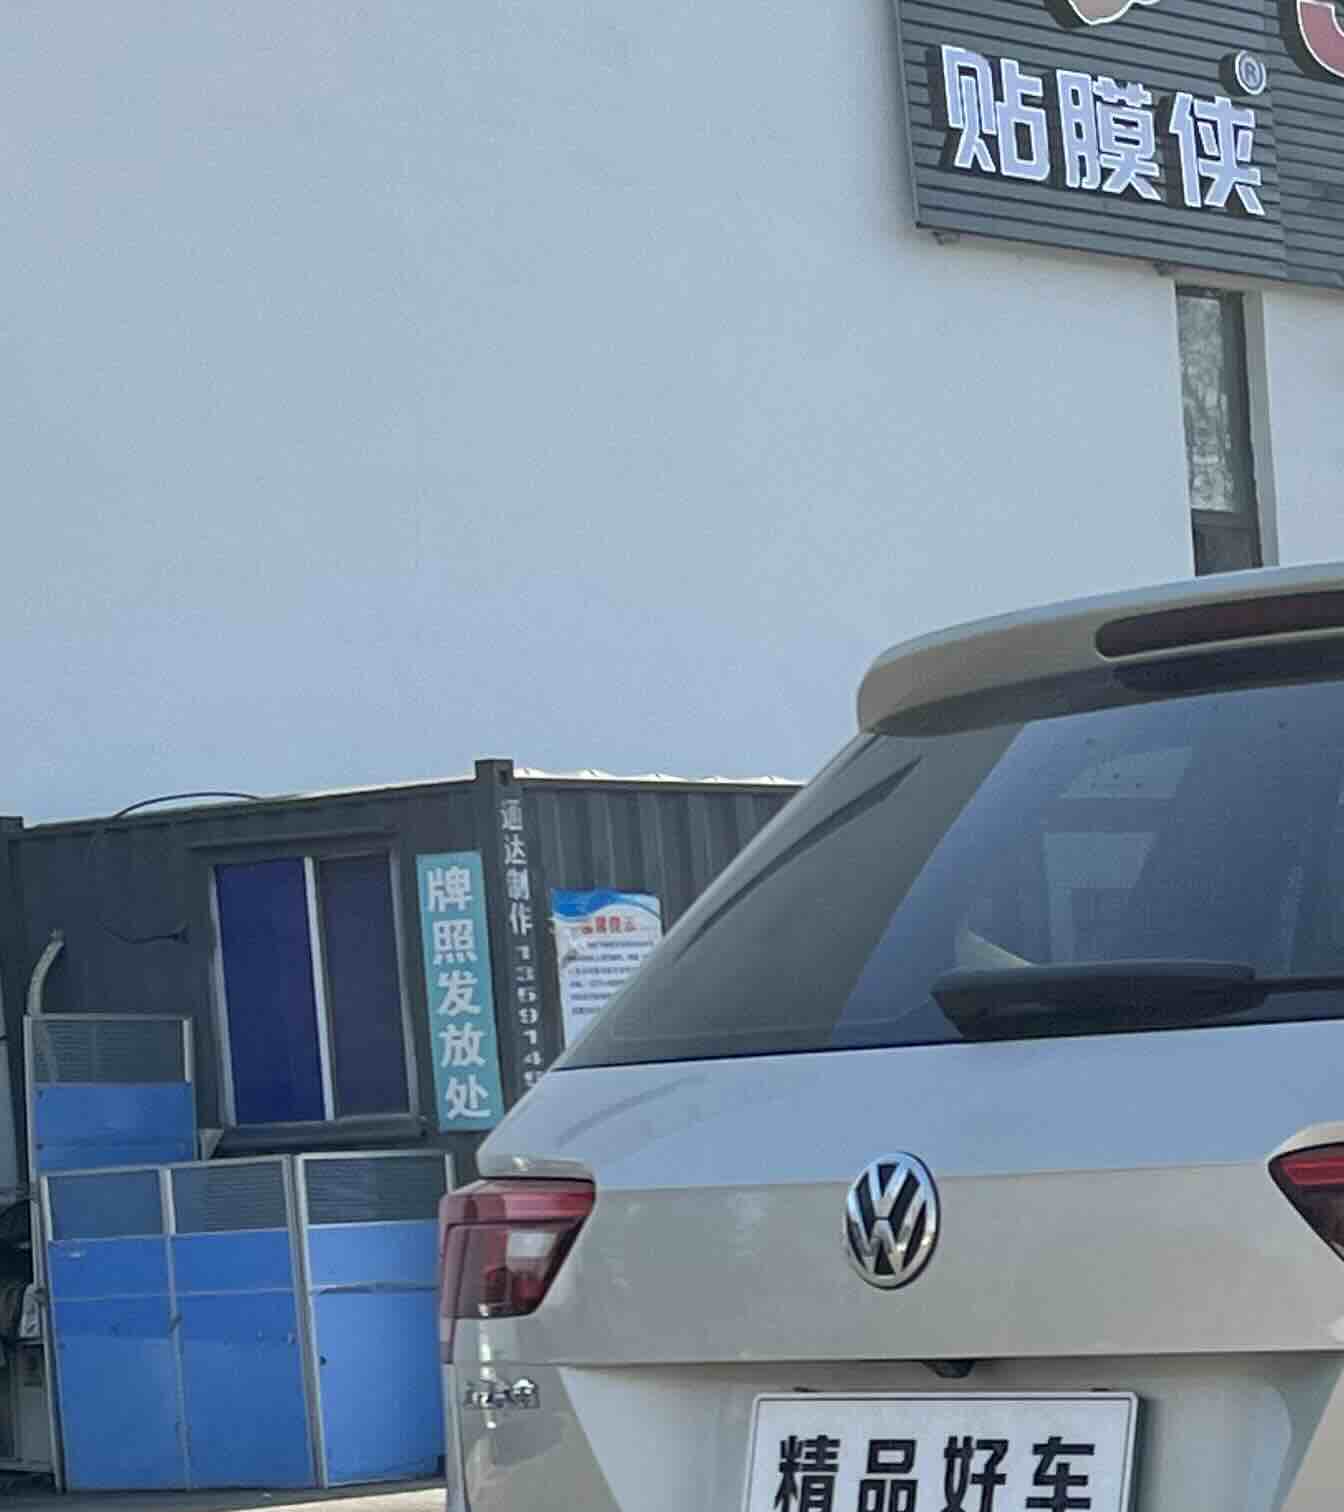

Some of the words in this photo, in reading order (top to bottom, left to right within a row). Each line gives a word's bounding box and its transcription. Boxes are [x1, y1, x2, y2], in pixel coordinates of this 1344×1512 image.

[941, 45, 1266, 216] 贴膜侠
[426, 866, 491, 1121] 牌照发放处
